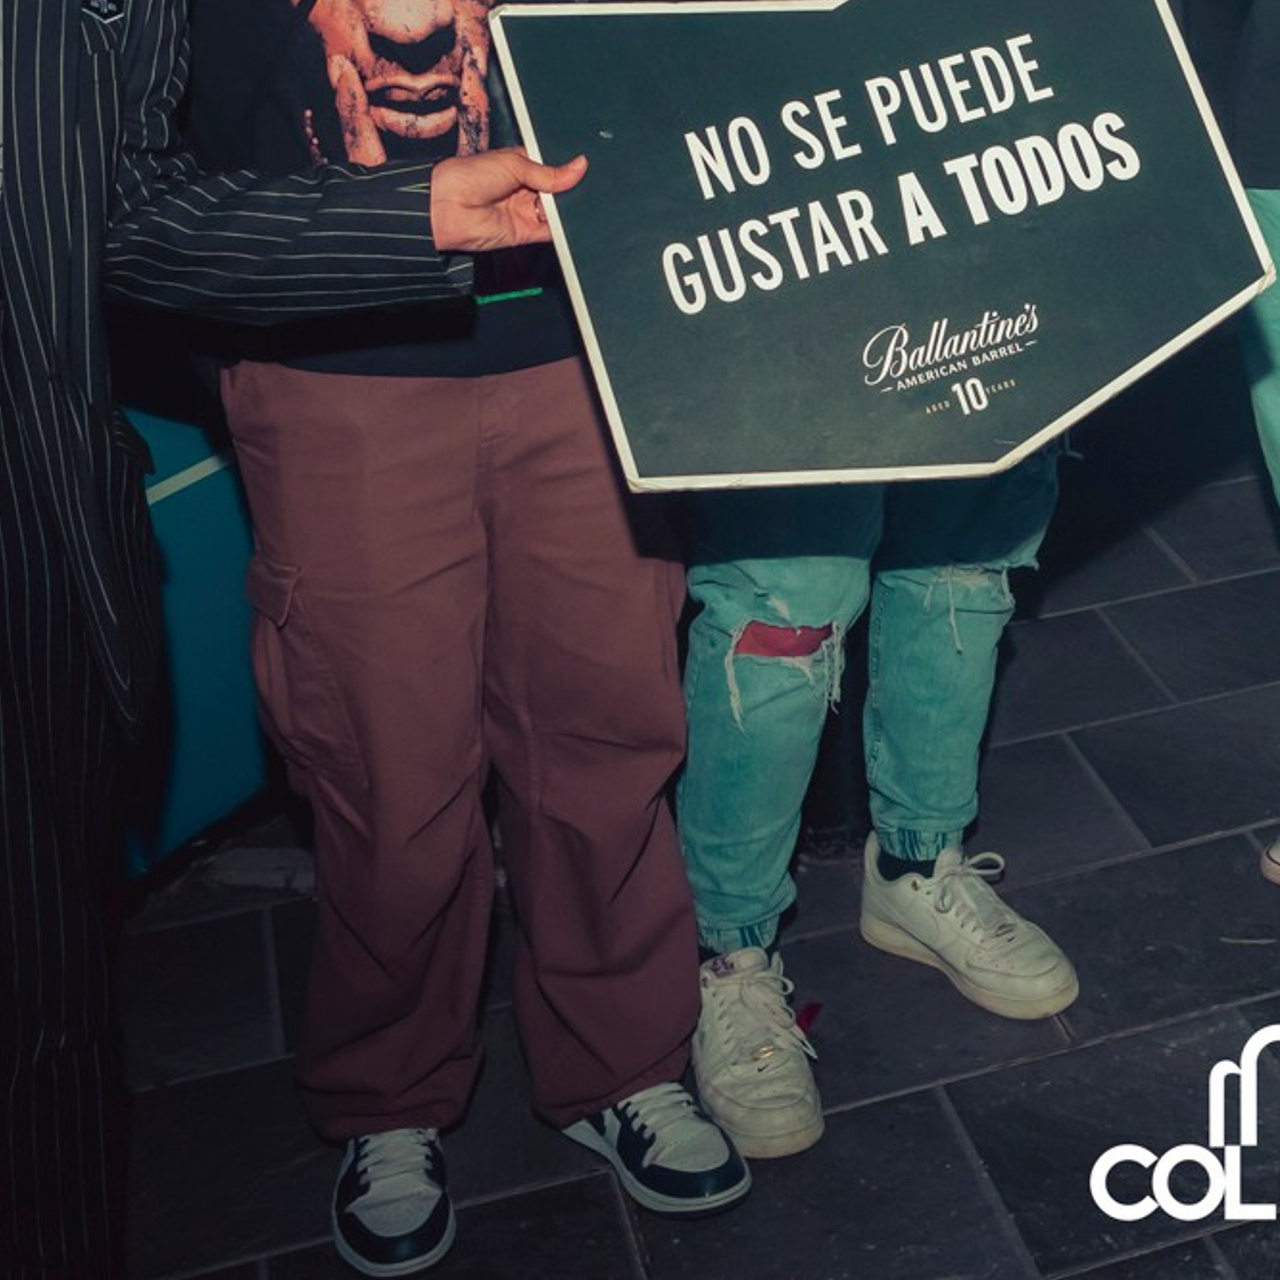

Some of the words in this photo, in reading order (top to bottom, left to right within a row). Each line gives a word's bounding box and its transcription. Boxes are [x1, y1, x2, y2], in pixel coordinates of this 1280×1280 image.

[683, 115, 771, 201] NO
[780, 88, 863, 170] SE
[864, 33, 1055, 146] PUEDE
[661, 189, 890, 316] GUSTAR
[897, 171, 948, 246] A
[942, 111, 1141, 226] TODOS
[862, 303, 1039, 386] Ballantine's
[896, 360, 968, 391] AMERICAN
[972, 342, 1024, 367] BARREL
[951, 376, 990, 416] 10
